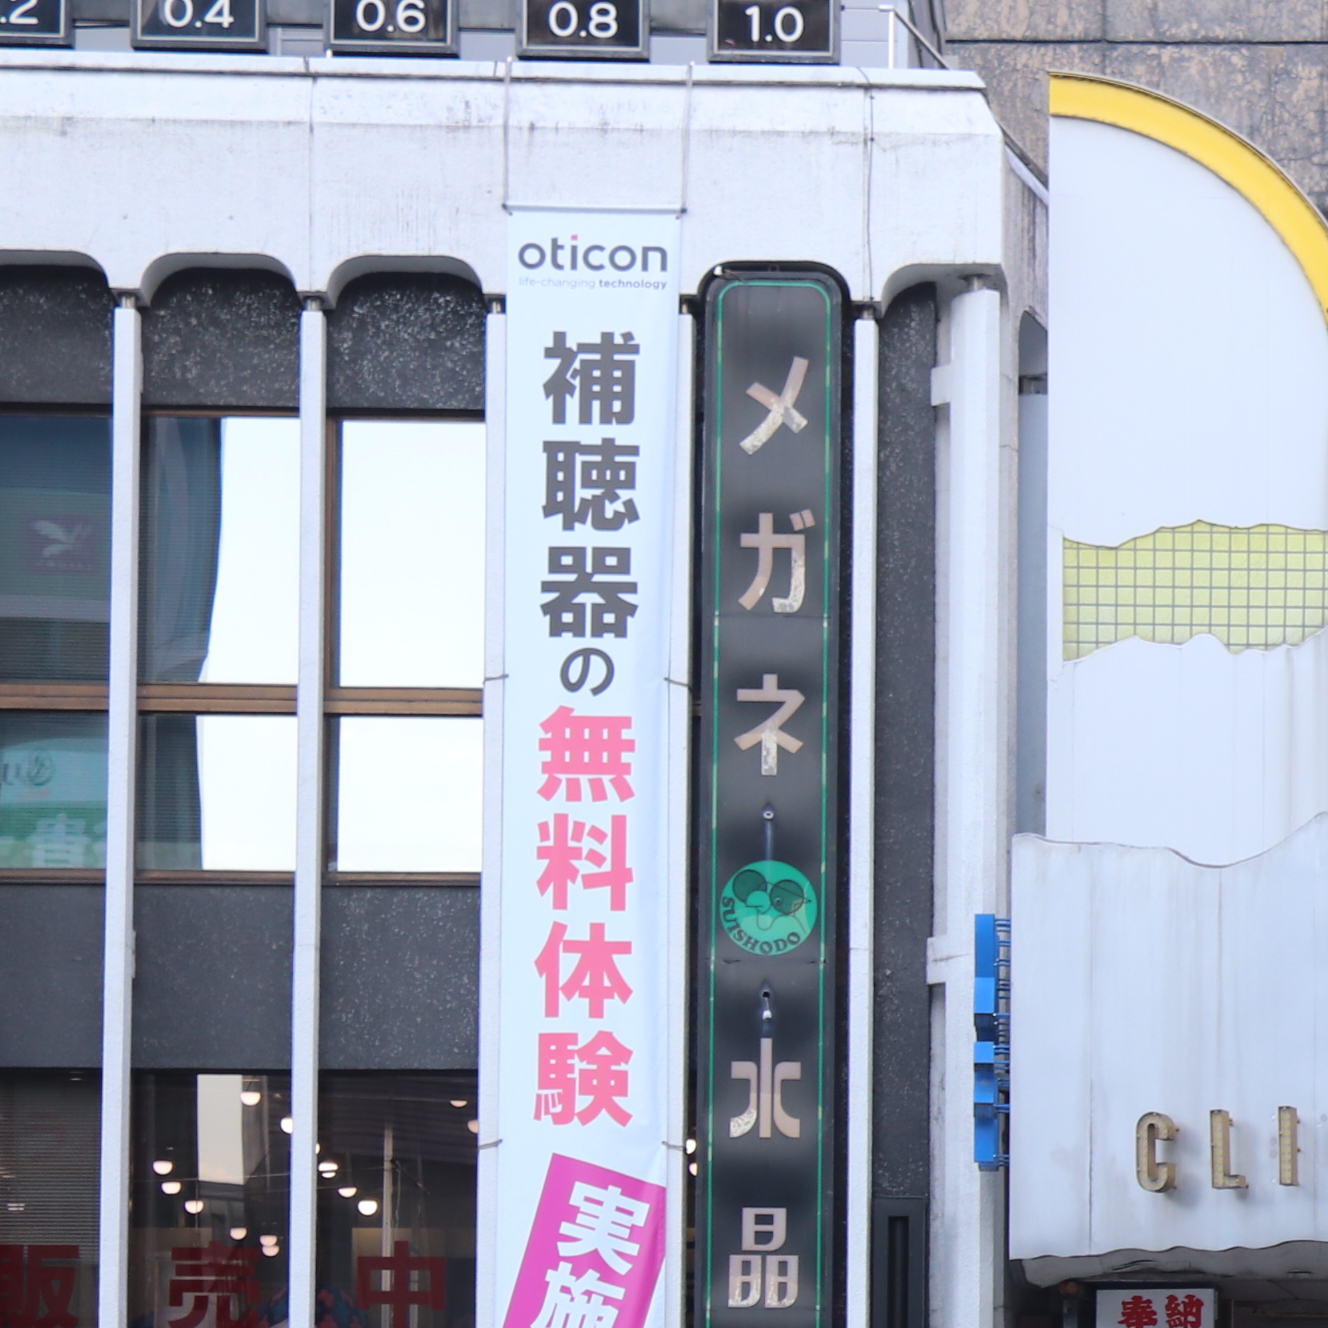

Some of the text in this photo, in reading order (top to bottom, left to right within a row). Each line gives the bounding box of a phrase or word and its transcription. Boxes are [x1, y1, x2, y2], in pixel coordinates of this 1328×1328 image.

[163, 0, 235, 29] 0.4
[356, 0, 428, 33] 0.6
[547, 1, 620, 39] 0.8
[744, 5, 805, 43] 1.0
[518, 234, 668, 273] oticon
[518, 275, 667, 291] life-changing technology
[734, 356, 816, 776] メガネ
[534, 331, 641, 1127] 補聴器の無料体験
[722, 895, 802, 954] SUISHODO
